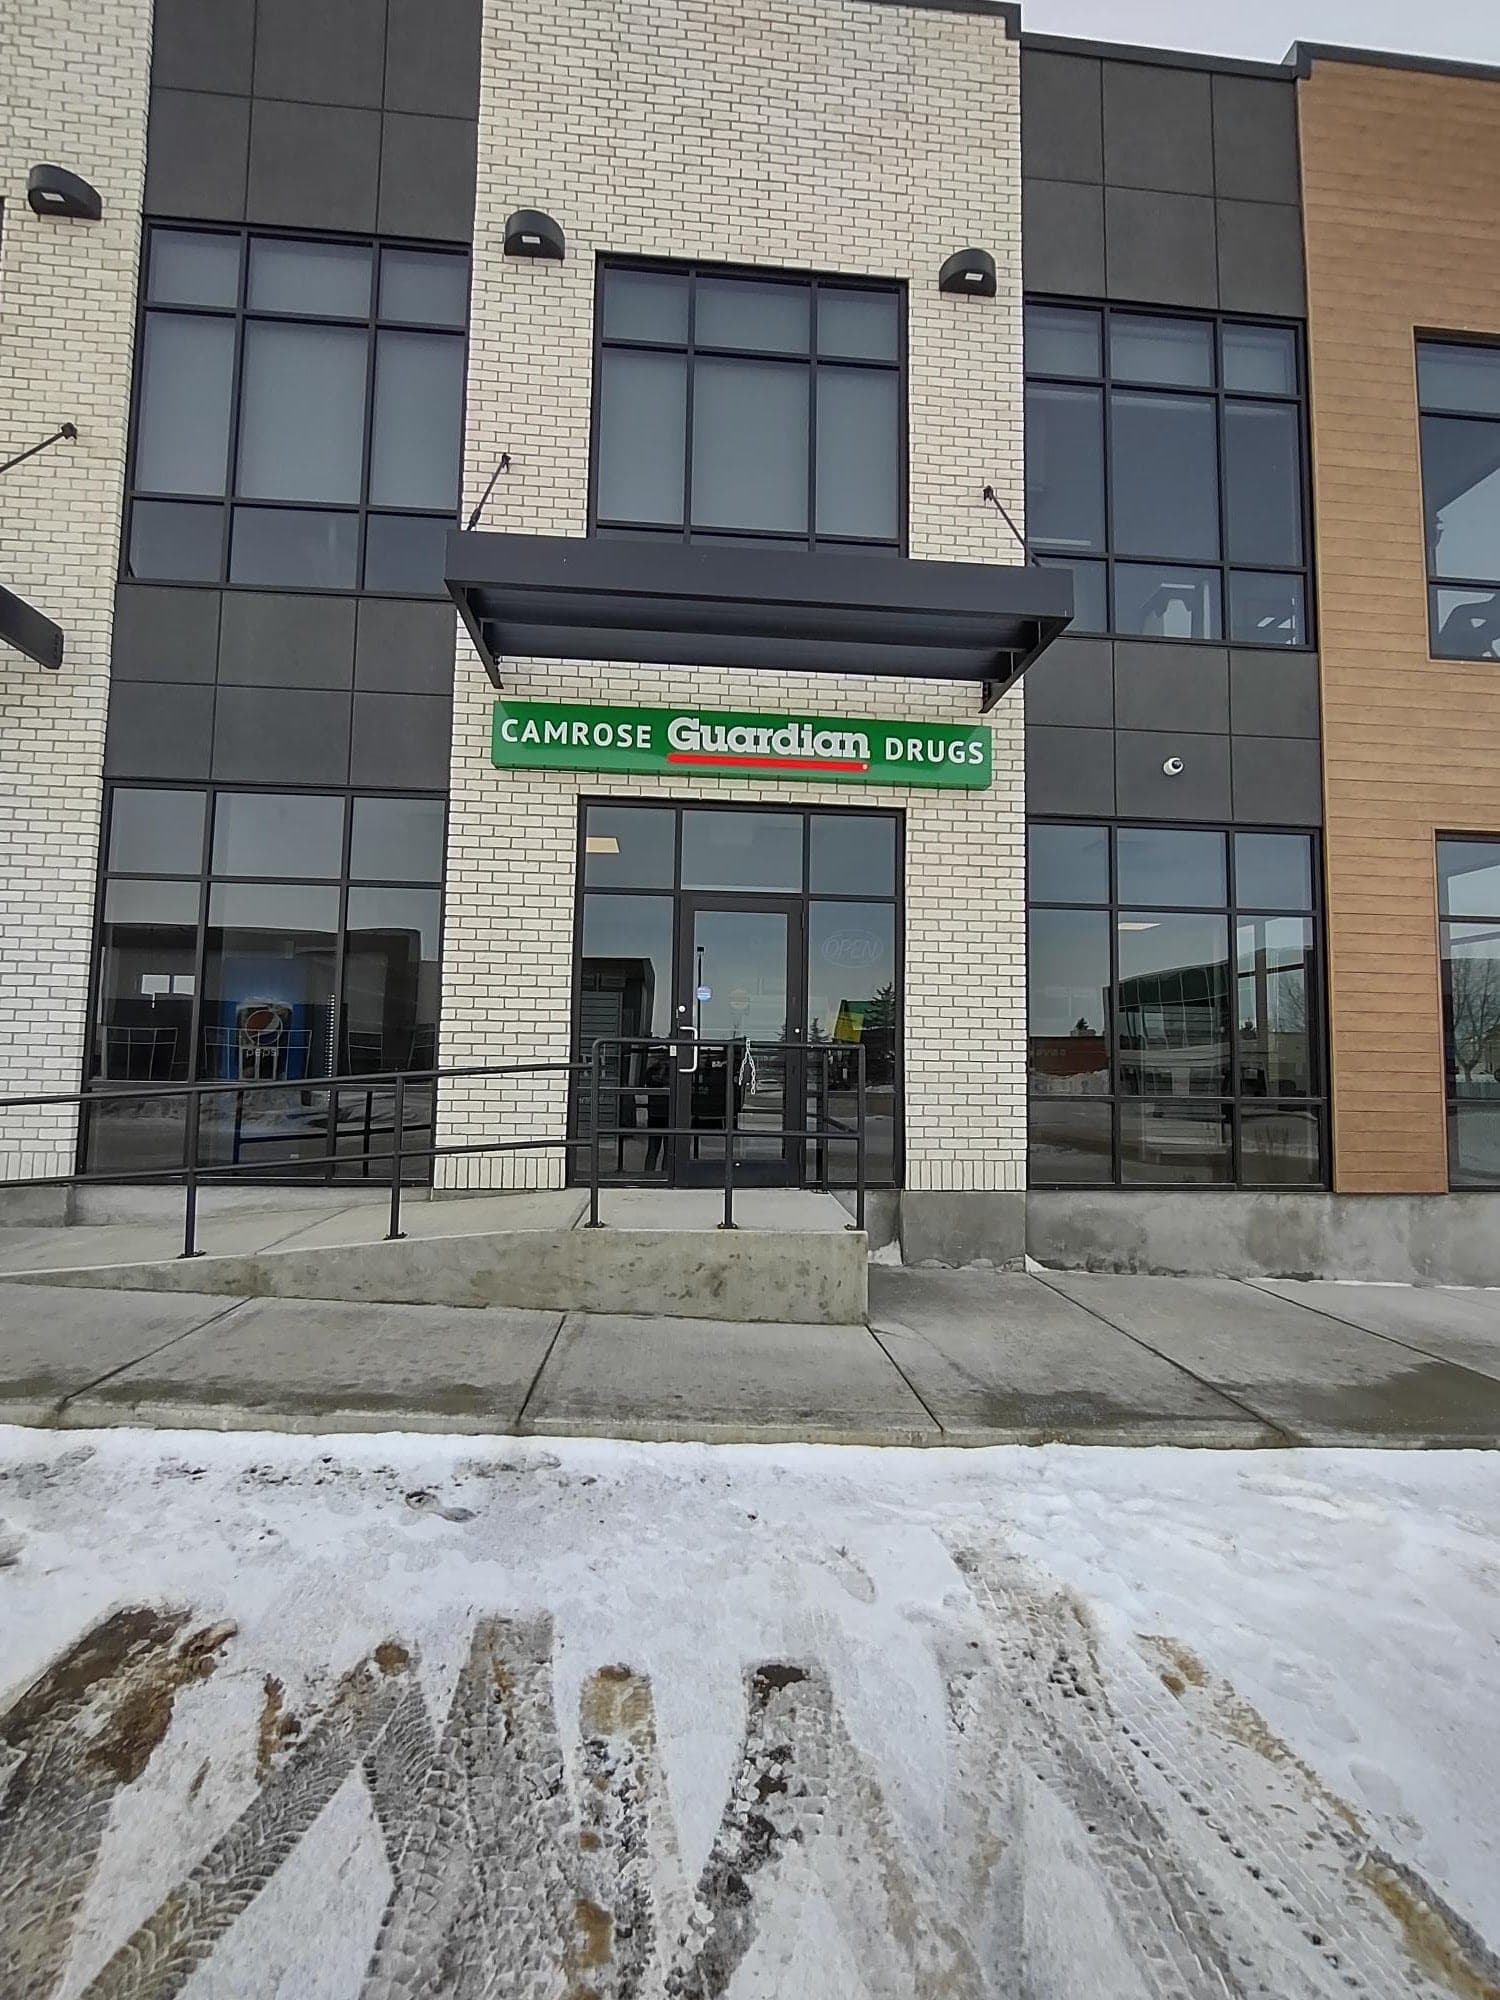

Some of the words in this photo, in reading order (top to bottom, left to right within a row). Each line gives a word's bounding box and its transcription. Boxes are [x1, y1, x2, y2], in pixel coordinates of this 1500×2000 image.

[501, 718, 652, 748] CAMROSE
[667, 716, 871, 759] Guardian
[885, 737, 984, 765] DRUGS
[825, 938, 880, 960] OPEN
